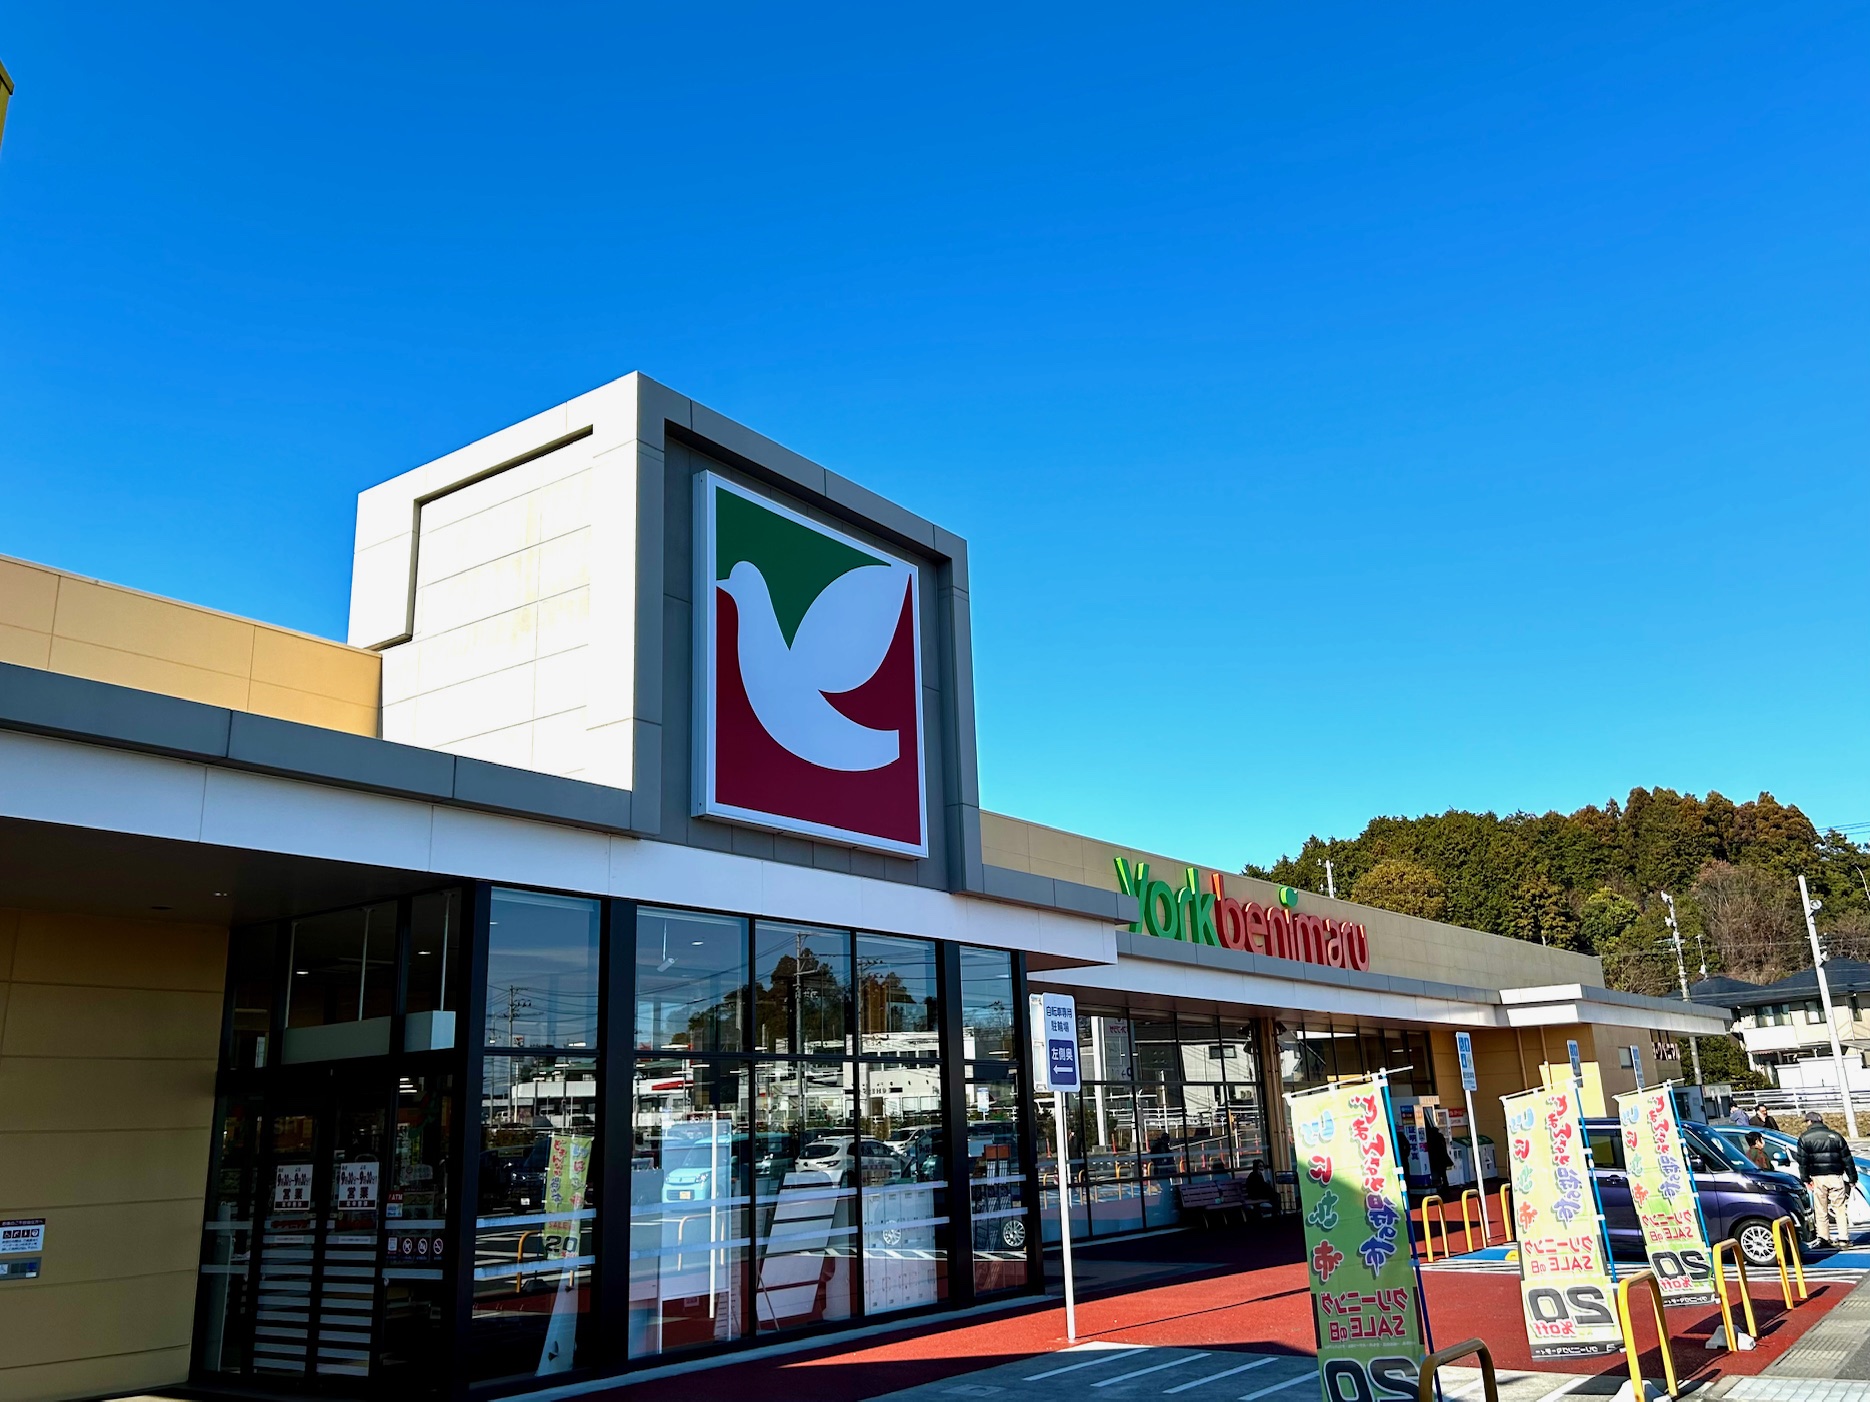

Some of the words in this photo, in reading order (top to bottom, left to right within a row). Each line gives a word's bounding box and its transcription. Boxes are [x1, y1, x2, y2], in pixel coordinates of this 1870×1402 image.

[1114, 857, 1369, 972] Yorkbenimaru
[1046, 1006, 1073, 1018] 自転車専用
[1051, 1020, 1070, 1033] 駐輪場
[1051, 1047, 1074, 1062] 左側奥
